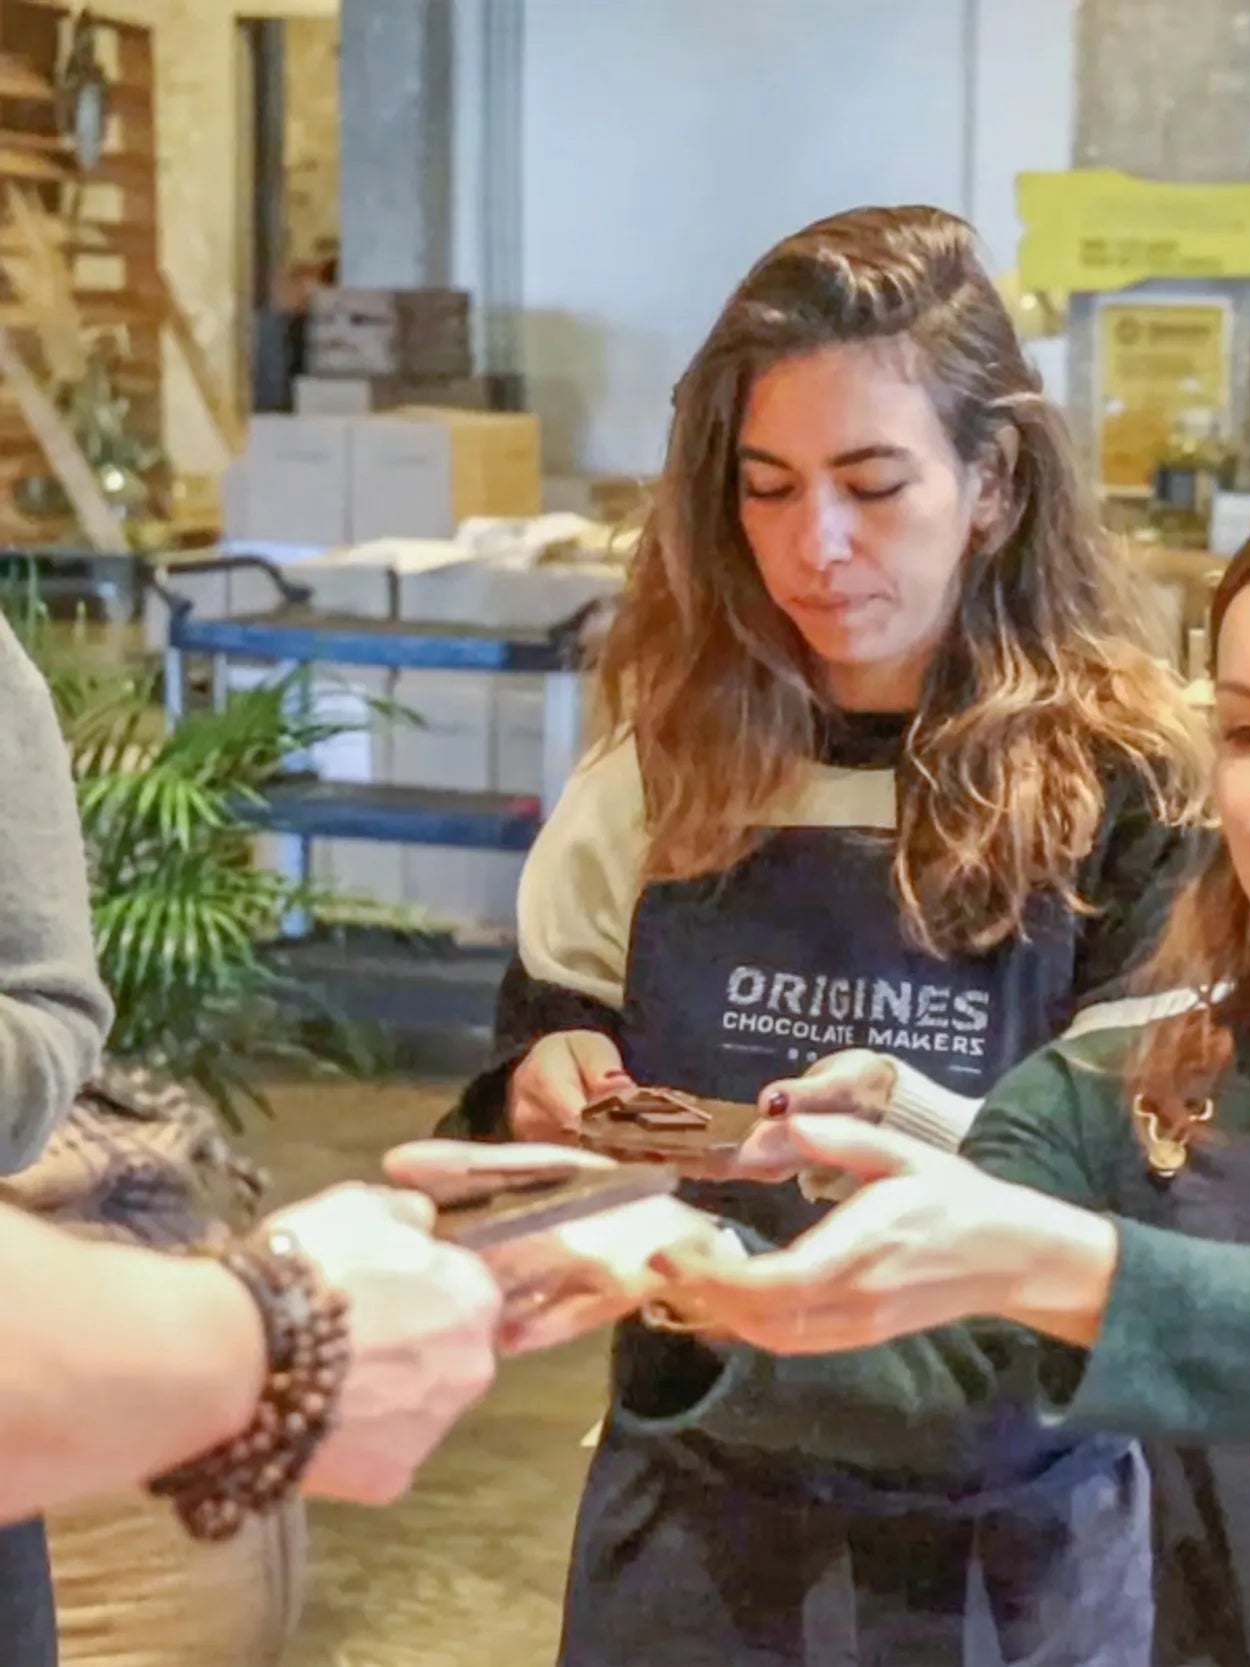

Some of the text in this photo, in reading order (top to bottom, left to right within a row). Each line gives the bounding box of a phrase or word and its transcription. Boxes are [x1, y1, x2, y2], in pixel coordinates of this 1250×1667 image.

[727, 965, 989, 1031] ORIGINES
[722, 1010, 985, 1056] CHOCOLATE MAKERS
